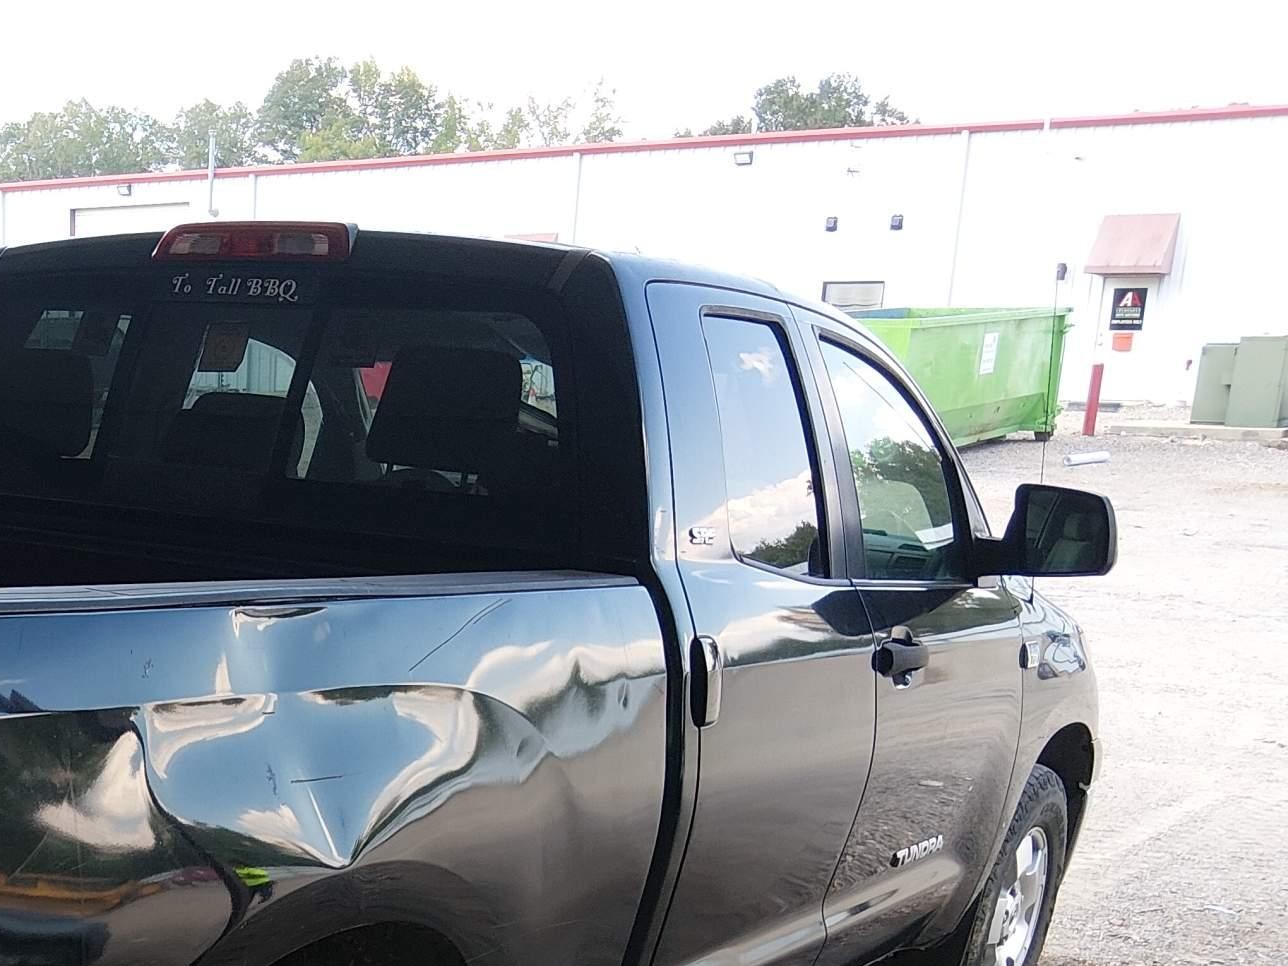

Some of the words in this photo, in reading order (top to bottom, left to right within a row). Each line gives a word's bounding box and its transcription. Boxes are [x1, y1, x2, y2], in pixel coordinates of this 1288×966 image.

[172, 273, 192, 294] To
[206, 273, 241, 296] Tall
[246, 278, 299, 302] BBQ
[893, 834, 944, 868] TUNDRA
